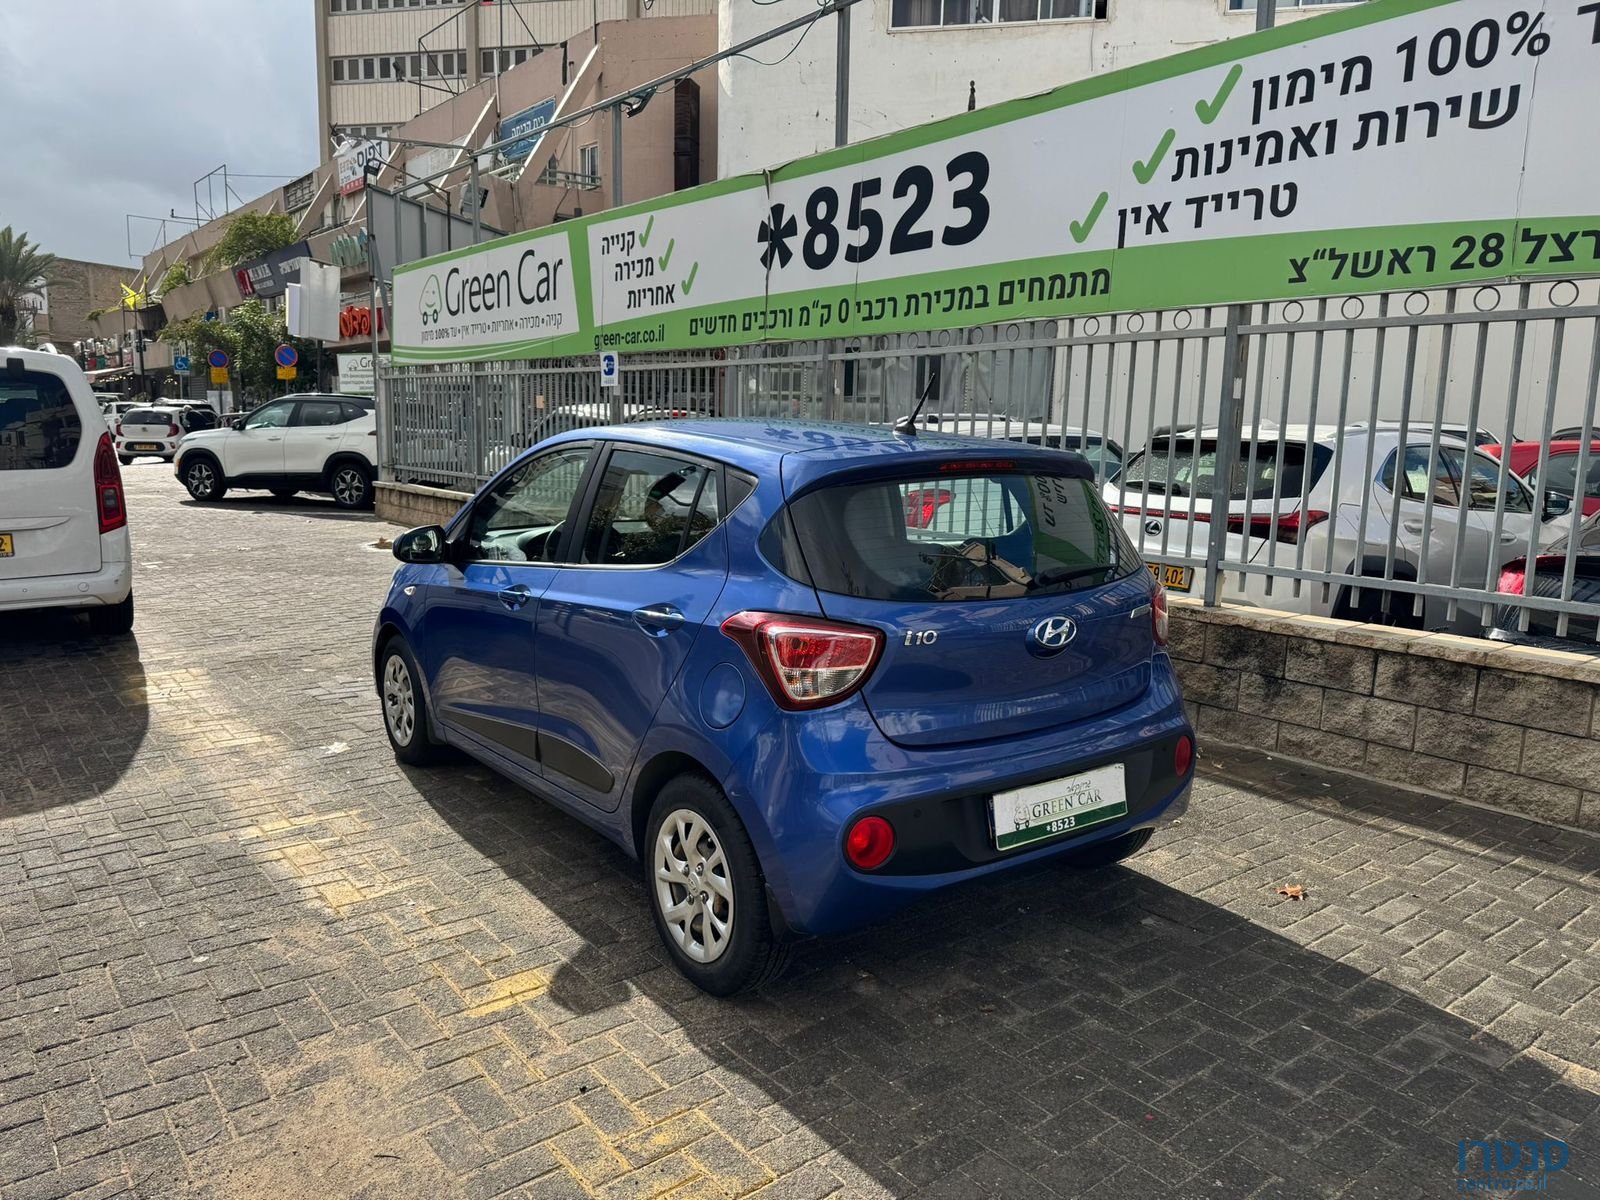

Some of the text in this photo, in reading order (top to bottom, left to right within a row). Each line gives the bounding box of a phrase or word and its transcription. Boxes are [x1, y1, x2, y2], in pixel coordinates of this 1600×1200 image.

[1396, 10, 1550, 82] 100%
[1252, 55, 1372, 126] מימון
[1171, 84, 1521, 182] שירות ואמינות
[1117, 181, 1298, 249] טרייד אין
[601, 230, 635, 256] קנייה
[1450, 232, 1504, 271] 28
[615, 256, 654, 281] מכירה
[445, 249, 563, 316] Green Car
[998, 268, 1110, 306] מתמחים
[627, 284, 675, 309] אחריות
[855, 296, 897, 321] רכבי
[904, 284, 989, 317] במכירת
[519, 315, 540, 330] מכירה
[545, 313, 563, 329] קניה
[742, 308, 793, 331] ורכבים
[838, 298, 849, 323] 0
[435, 327, 450, 339] 100%
[491, 319, 514, 333] אחריות
[594, 324, 665, 350] green-car.co.il
[689, 314, 737, 336] חדשים
[904, 630, 938, 646] i10
[1032, 789, 1102, 818] GREEN CAR
